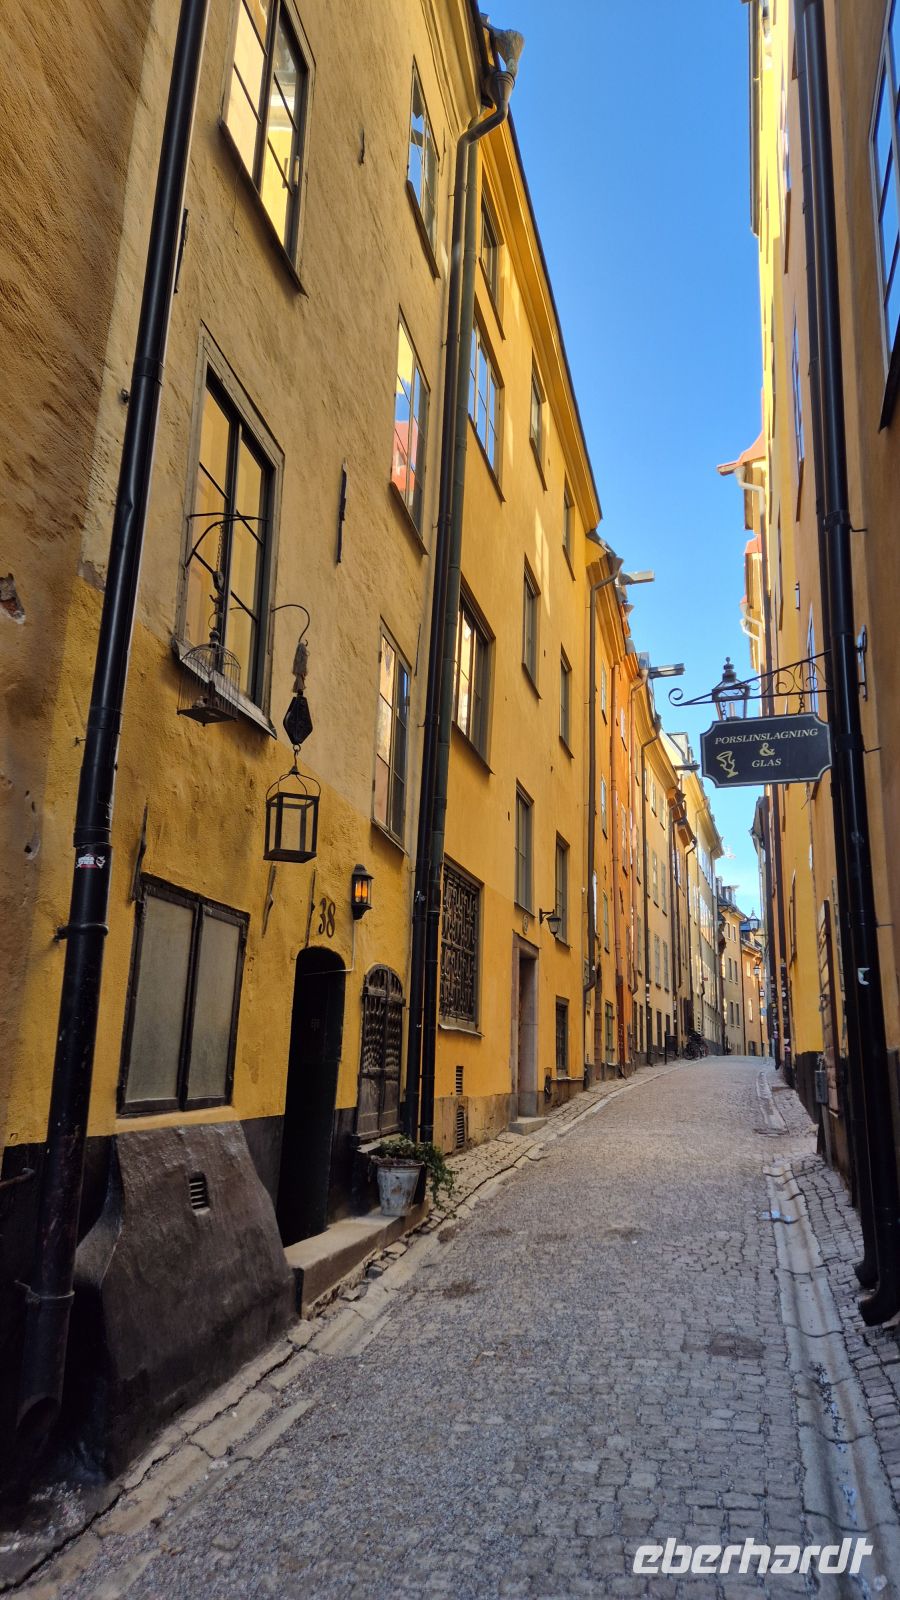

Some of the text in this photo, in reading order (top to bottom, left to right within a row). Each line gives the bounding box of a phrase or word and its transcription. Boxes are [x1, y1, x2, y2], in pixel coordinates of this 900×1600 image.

[715, 728, 818, 745] PORSLINSLAGNING
[759, 742, 775, 756] &
[751, 758, 782, 768] GLAS
[318, 897, 336, 939] 38
